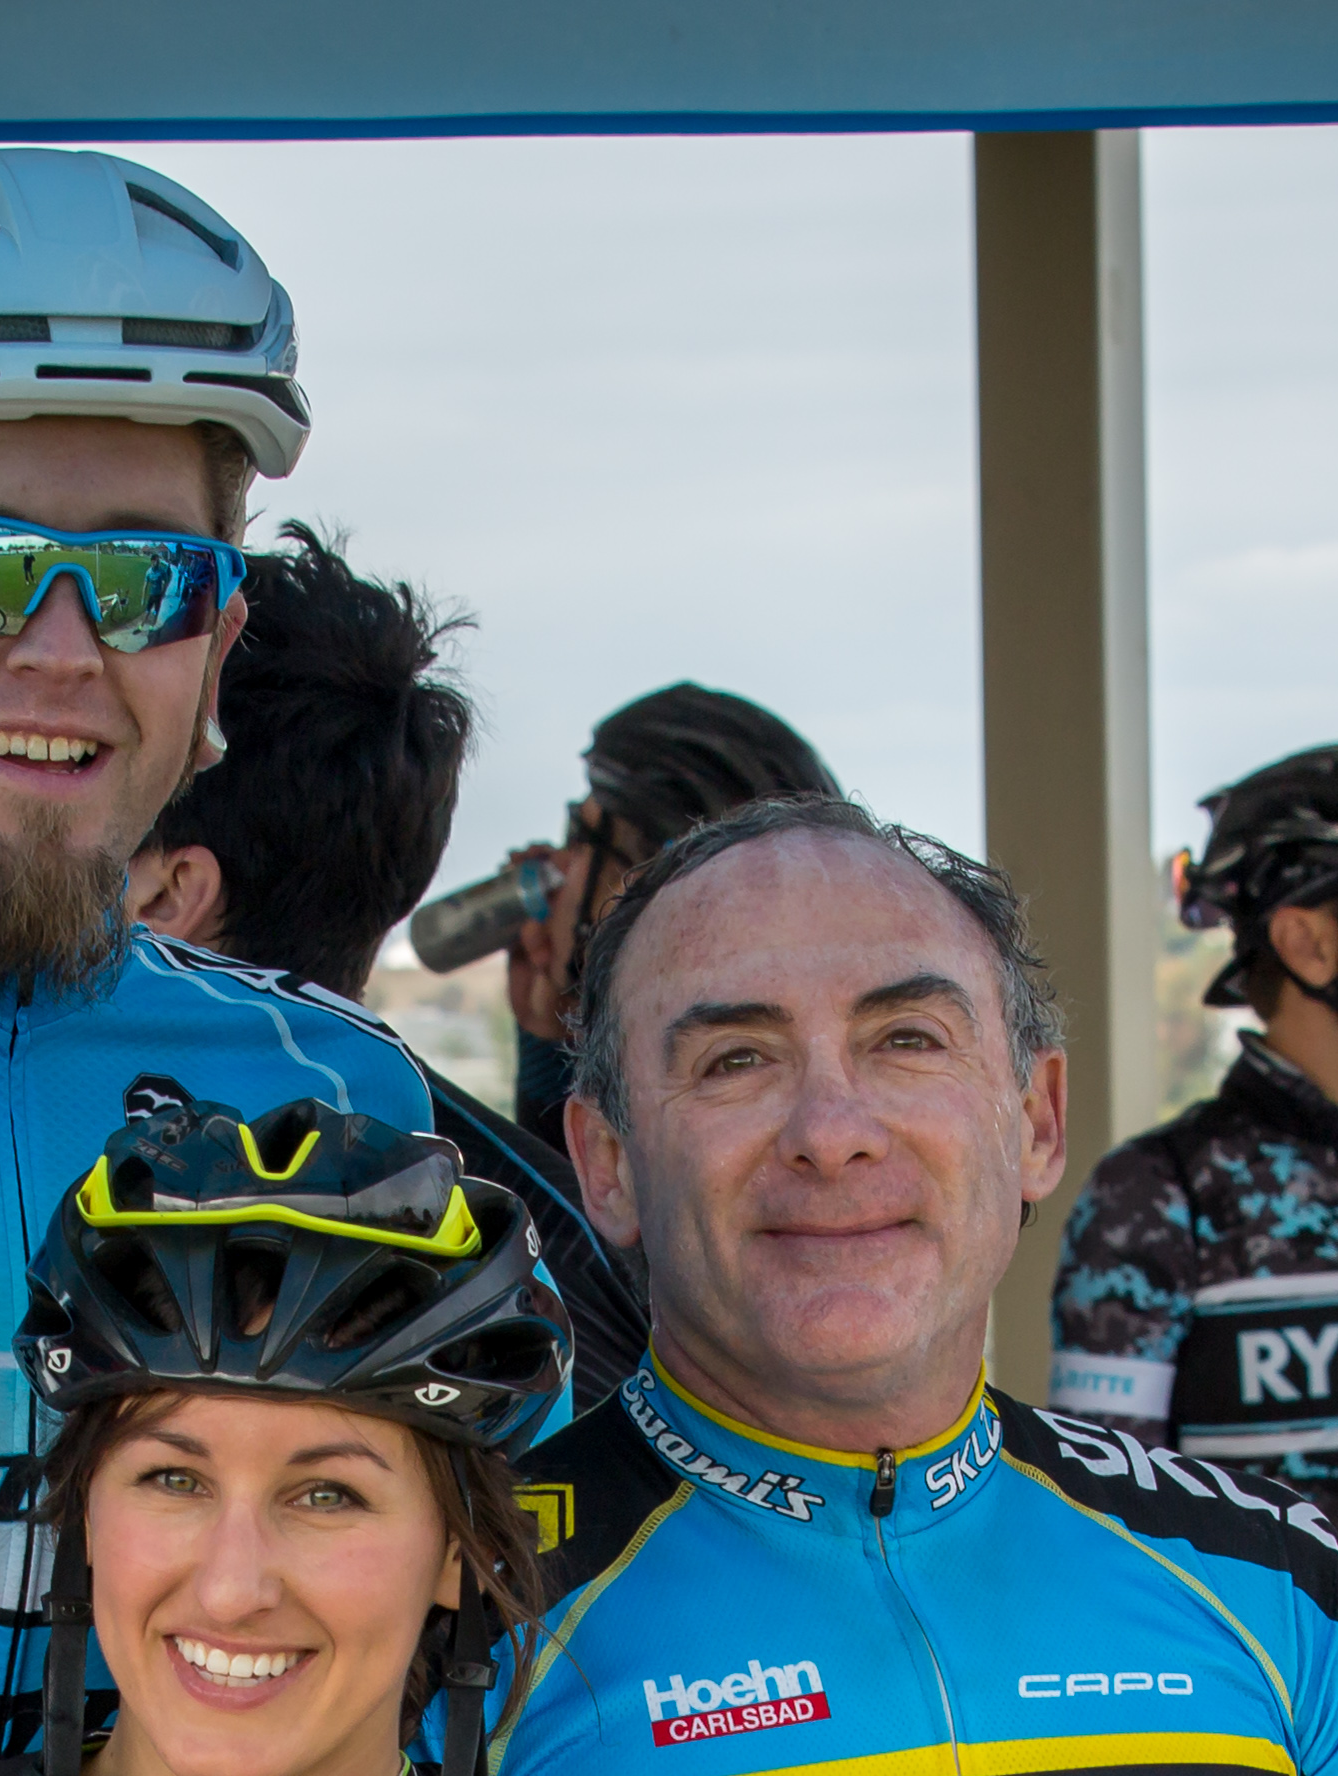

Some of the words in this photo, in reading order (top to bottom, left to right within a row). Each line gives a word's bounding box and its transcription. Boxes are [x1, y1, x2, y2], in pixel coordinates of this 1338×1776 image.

[621, 1367, 825, 1522] Swami's
[925, 1395, 1002, 1511] SKLZ
[644, 1659, 823, 1722] Hoehn
[1018, 1672, 1194, 1698] CAPO
[668, 1694, 815, 1743] CARLSBAD
